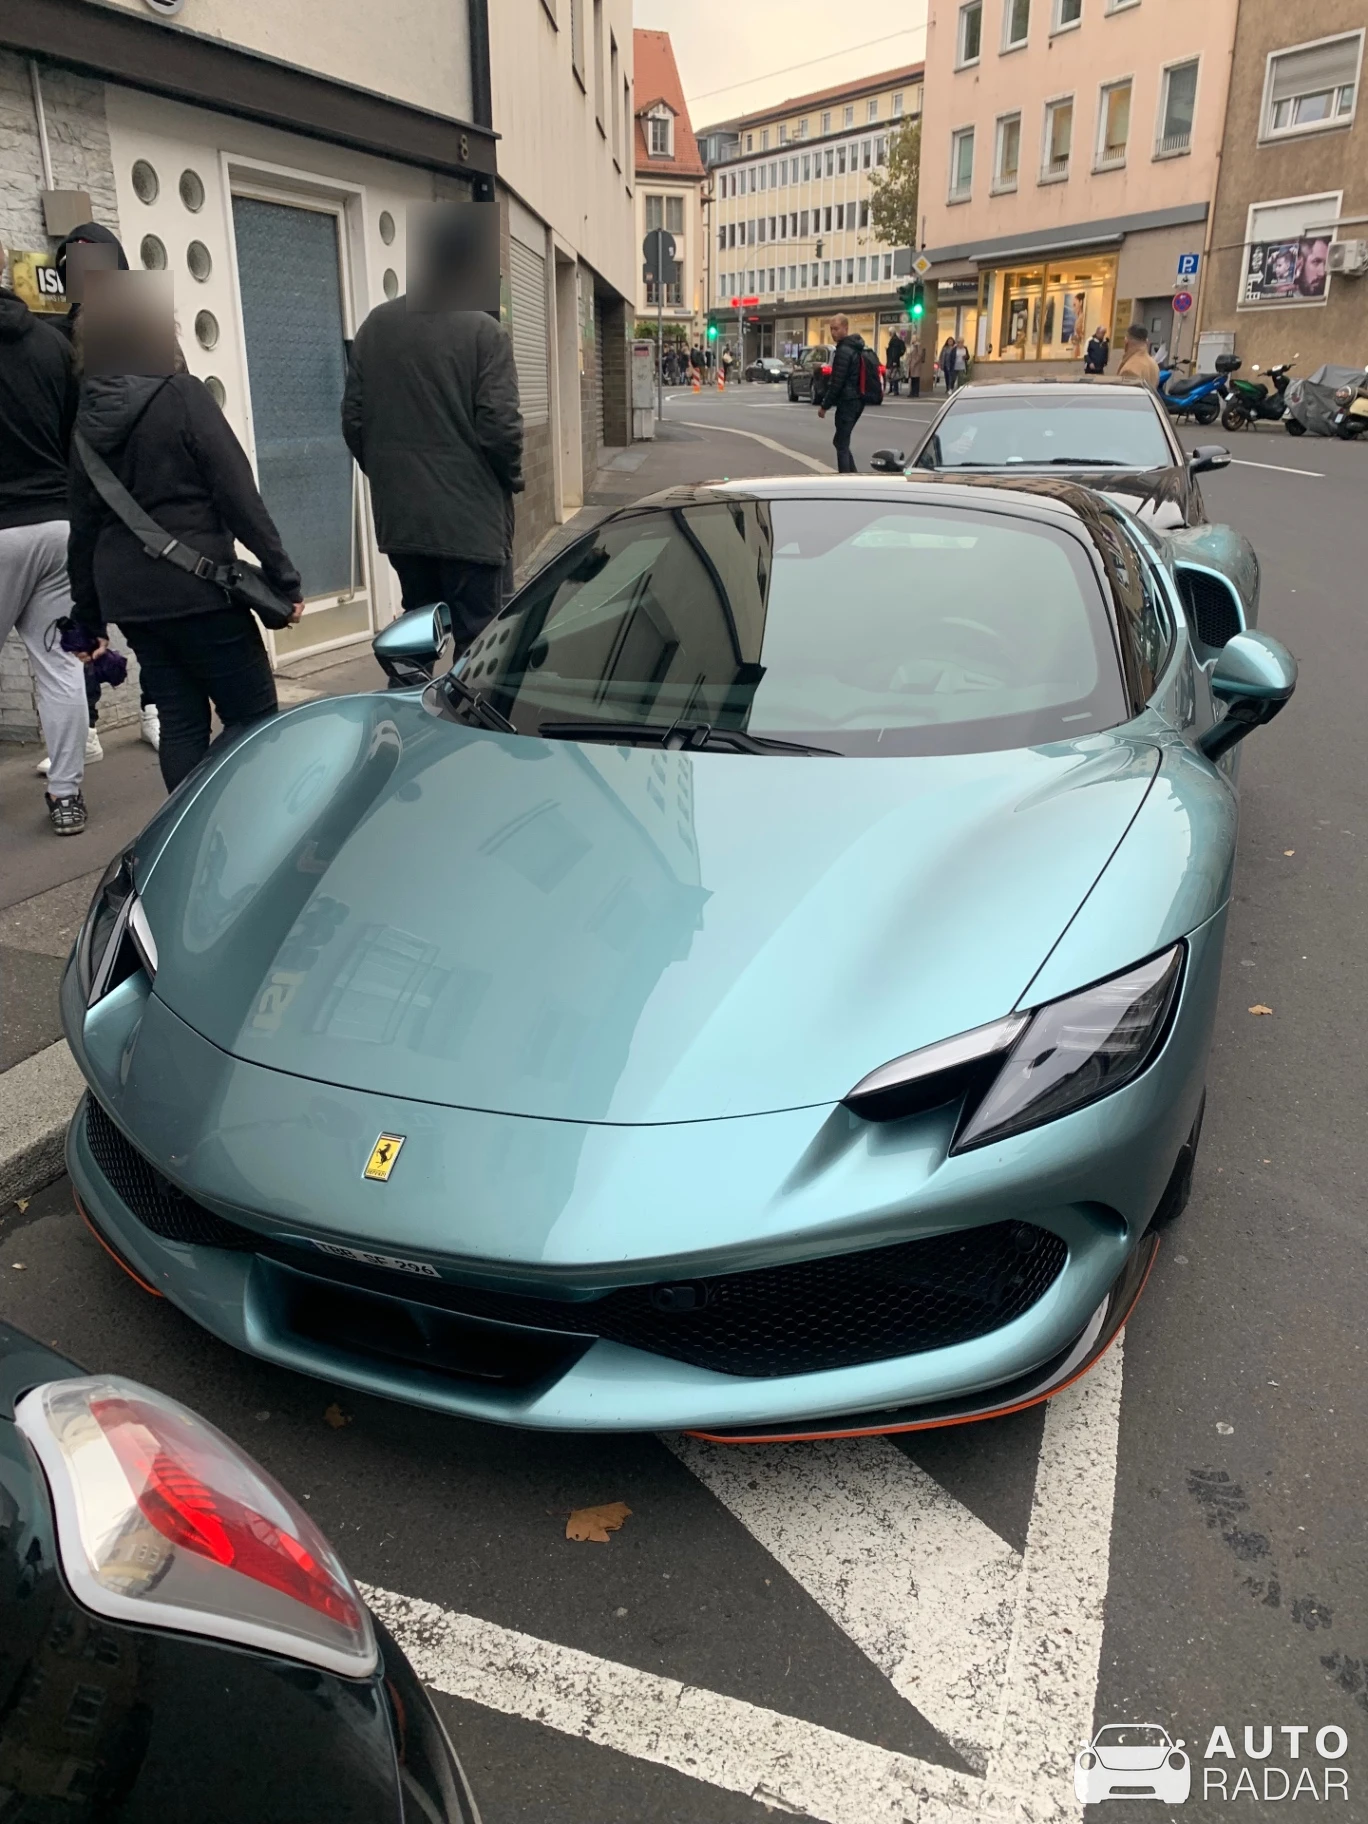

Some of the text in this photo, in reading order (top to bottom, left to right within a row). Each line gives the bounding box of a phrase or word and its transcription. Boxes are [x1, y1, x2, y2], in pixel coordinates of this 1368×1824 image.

[461, 134, 469, 160] 8
[1182, 256, 1194, 273] P
[394, 1260, 435, 1275] 296
